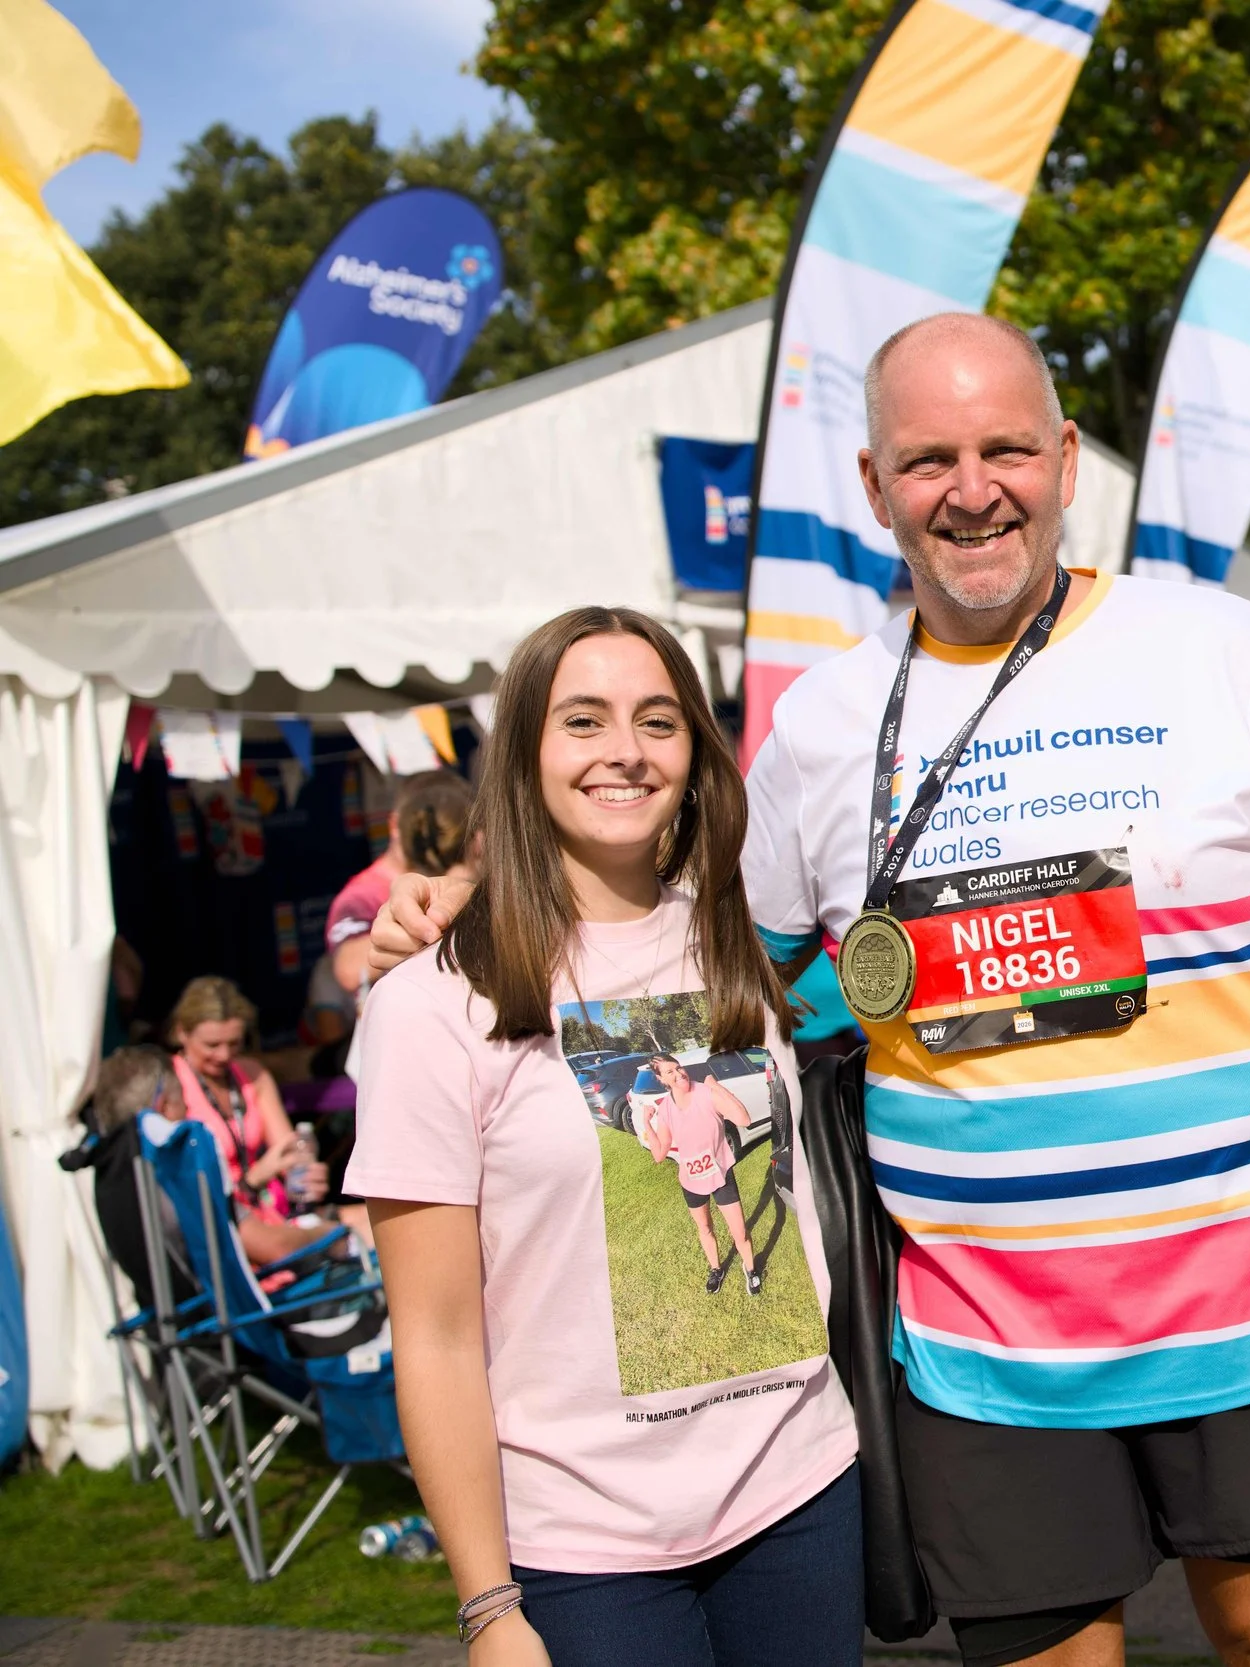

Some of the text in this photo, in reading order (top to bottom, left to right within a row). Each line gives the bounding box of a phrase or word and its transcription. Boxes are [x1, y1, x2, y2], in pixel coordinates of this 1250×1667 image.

[327, 254, 467, 306] Alzheimer's
[369, 283, 463, 336] Society
[1009, 645, 1033, 676] 2026
[884, 721, 896, 752] 2026
[919, 725, 1169, 773] chwil canser
[920, 785, 1160, 834] ancer research
[883, 846, 904, 878] 2026
[912, 836, 1002, 869] wales
[967, 860, 1078, 891] CARDIFF HALF
[969, 877, 1080, 901] HANNER MARATHON CAERDYDD
[952, 907, 1072, 955] NIGEL
[955, 946, 1081, 995] 18836
[1059, 983, 1111, 998] UNISEX 2XL
[943, 1006, 959, 1015] RED
[1017, 1020, 1032, 1029] 2026
[921, 1026, 947, 1042] R4W
[686, 1154, 714, 1175] 232
[626, 1379, 805, 1423] HALF MARATHON, MORE LIKE A MIDLIFE CRISIS WITH
